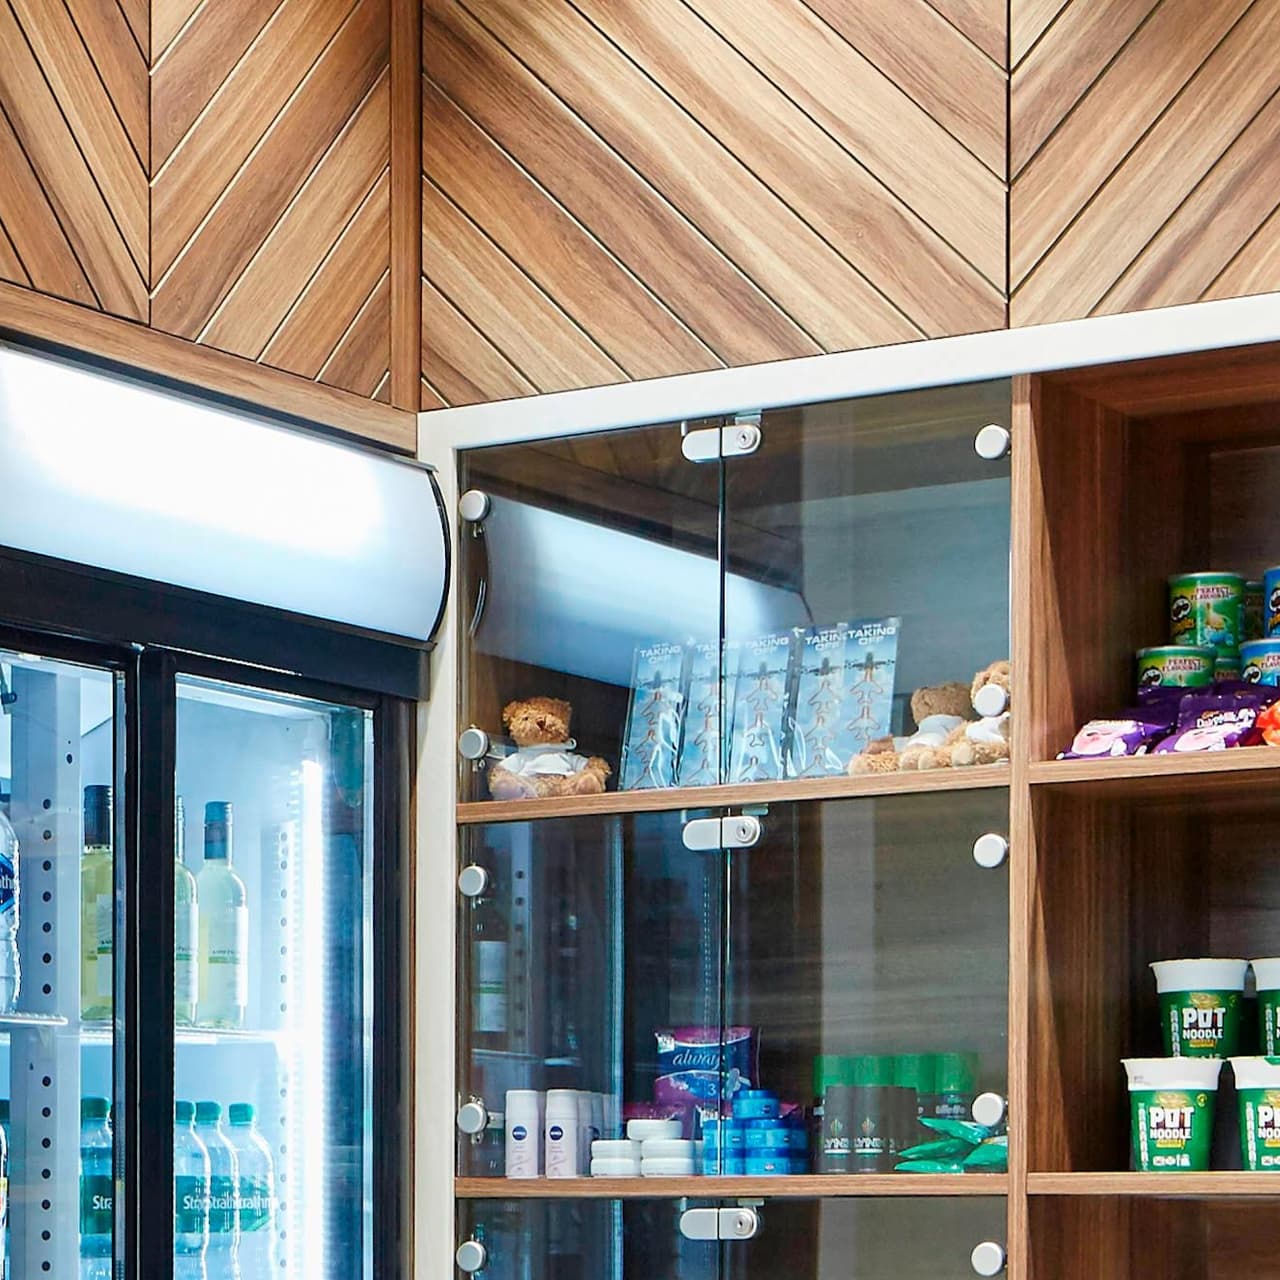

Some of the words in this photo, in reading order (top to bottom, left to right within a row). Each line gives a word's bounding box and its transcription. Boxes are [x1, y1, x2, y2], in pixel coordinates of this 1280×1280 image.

[848, 627, 896, 639] TAKING
[1183, 1007, 1226, 1029] POT
[1183, 1028, 1224, 1040] NOODLE
[708, 1083, 717, 1097] 3
[1149, 1106, 1195, 1128] POT
[1150, 1128, 1192, 1139] NOODLE
